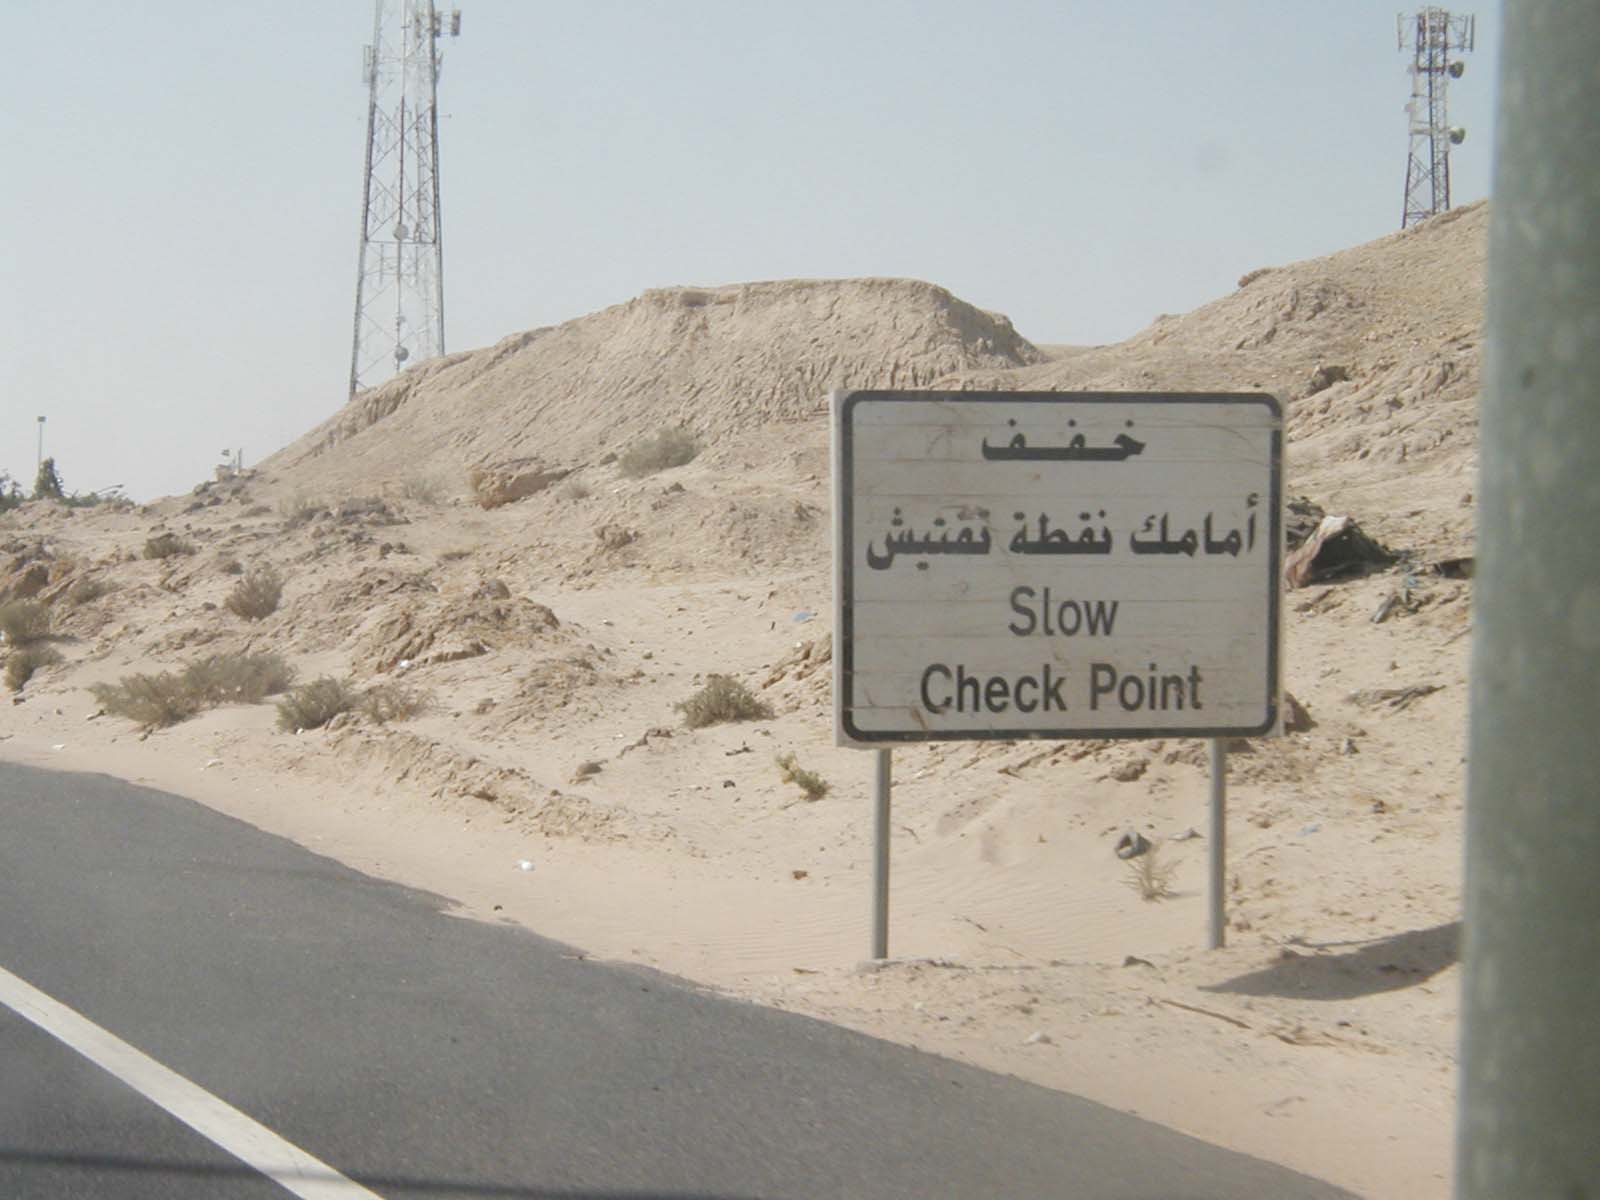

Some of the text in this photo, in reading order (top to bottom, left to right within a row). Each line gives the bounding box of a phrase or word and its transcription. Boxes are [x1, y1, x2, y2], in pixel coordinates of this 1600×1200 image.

[982, 418, 1147, 461] خفف
[866, 492, 1259, 570] أمامك نقطة تفتيش
[1008, 586, 1119, 636] Slow
[920, 662, 1203, 713] Check Point
